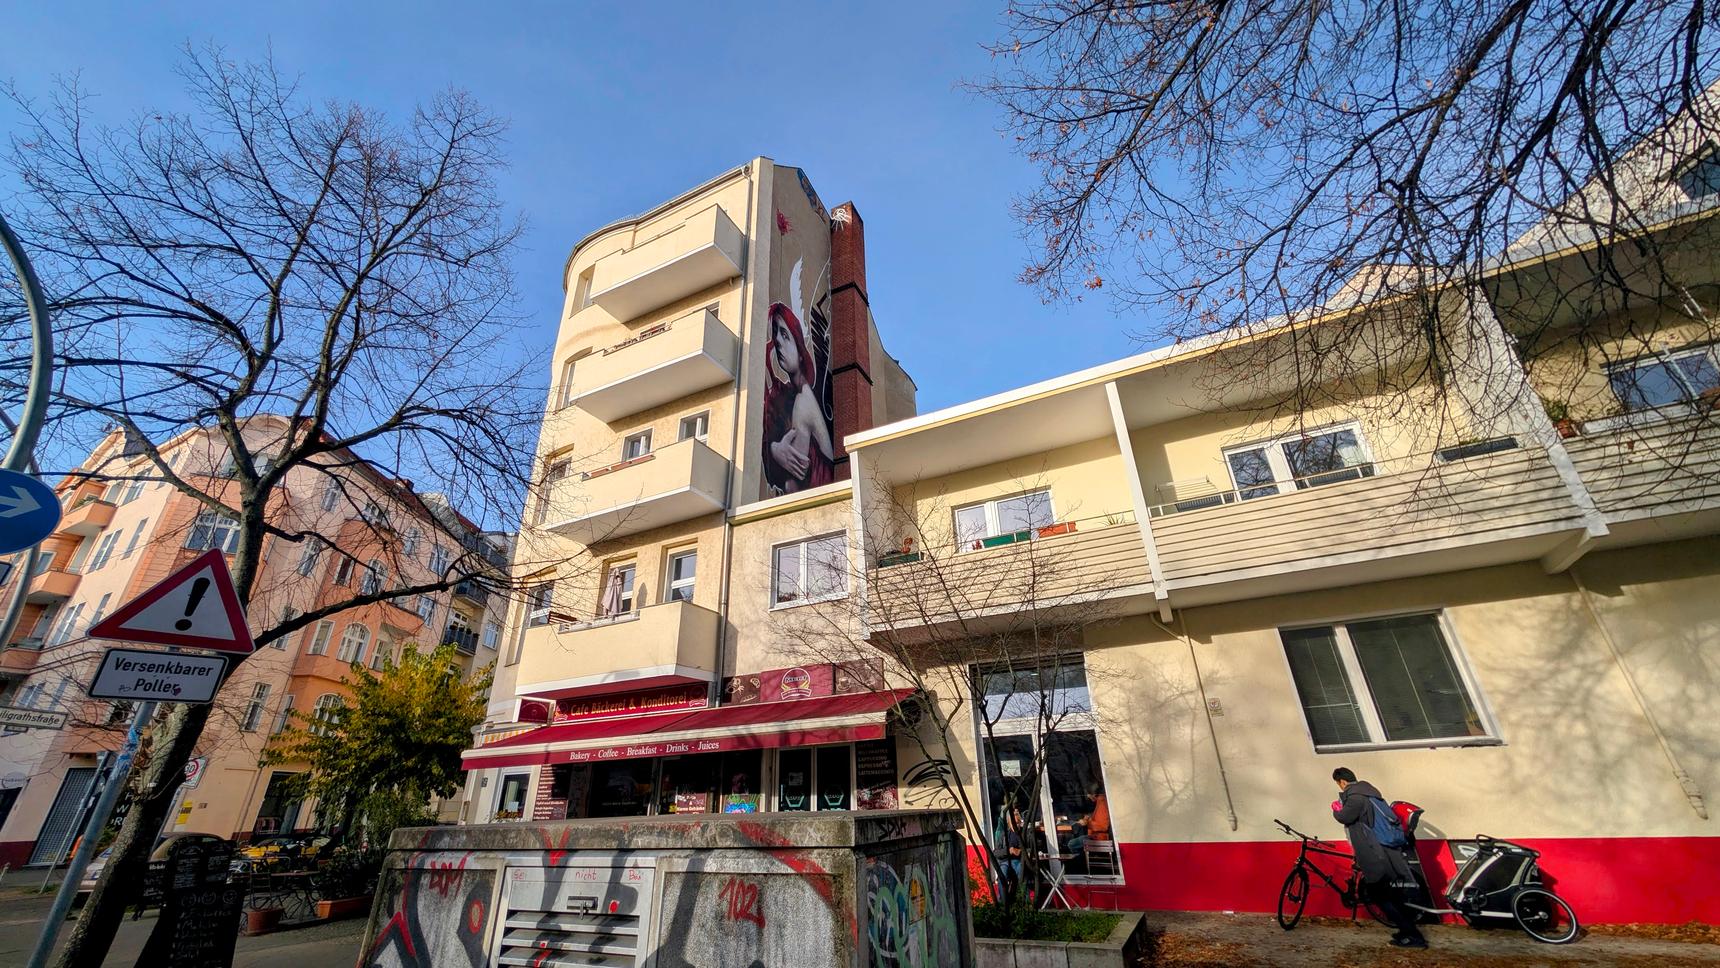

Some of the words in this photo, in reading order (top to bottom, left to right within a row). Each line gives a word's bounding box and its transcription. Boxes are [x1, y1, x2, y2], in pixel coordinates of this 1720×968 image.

[114, 657, 214, 676] Versenkbarer
[133, 678, 180, 693] Poller
[628, 698, 636, 710] &
[640, 691, 687, 709] Konditorei
[570, 752, 590, 761] Bakery
[597, 748, 618, 758] Coffee
[626, 746, 657, 756] Breakfast
[665, 743, 689, 753] Drinks
[697, 740, 720, 751] Juices
[575, 869, 598, 880] nicht
[719, 877, 766, 928] 102
